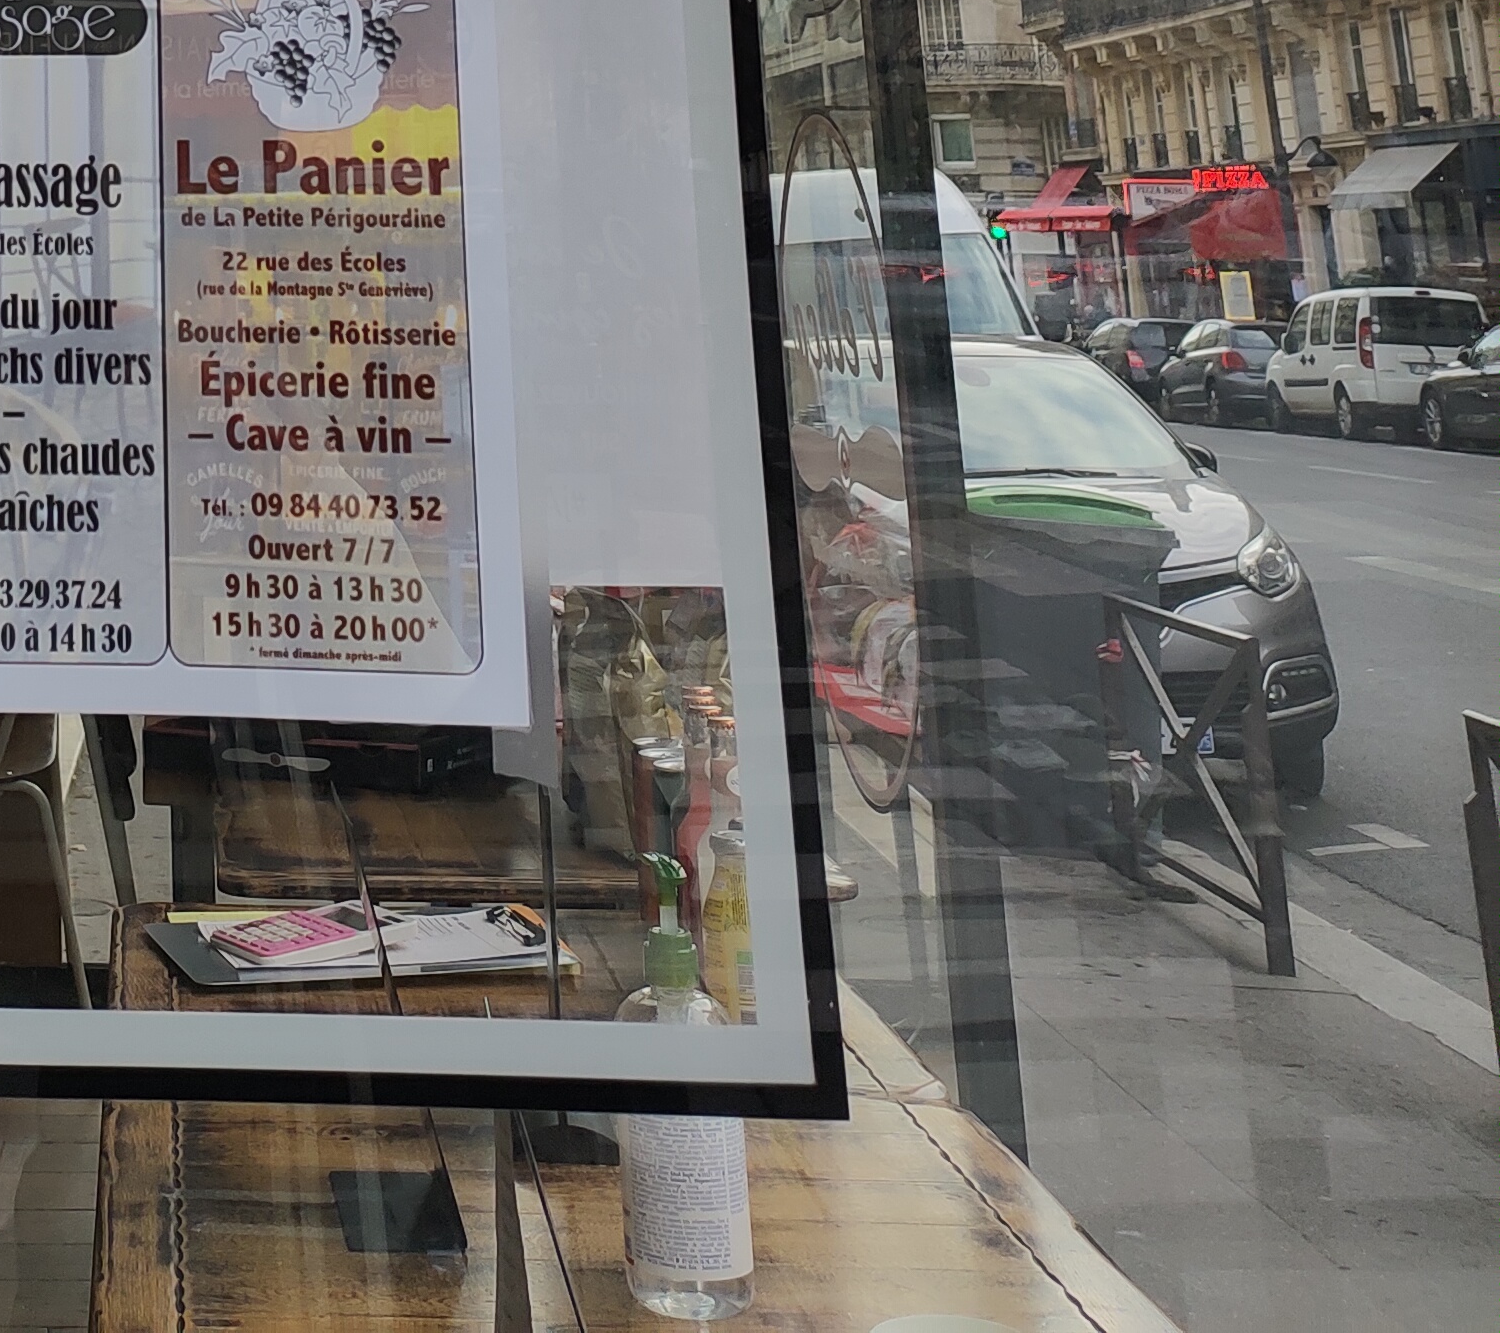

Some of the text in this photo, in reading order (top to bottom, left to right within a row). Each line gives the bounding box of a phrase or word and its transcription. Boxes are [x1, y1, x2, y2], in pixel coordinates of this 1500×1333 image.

[176, 139, 450, 196] Le Panier
[1201, 168, 1270, 190] PIZZA
[181, 206, 446, 233] de La Petite Périgourdine
[33, 228, 94, 256] Écoles
[222, 246, 407, 272] 22 rue des Écoles
[197, 281, 218, 300] (rue
[229, 281, 246, 296] de
[250, 281, 263, 296] la
[267, 282, 333, 300] Montagne
[359, 282, 434, 301] Geneviève)
[0, 293, 40, 330] du
[50, 293, 117, 335] jour
[178, 319, 456, 347] Boucherie Rôtisserie
[54, 347, 151, 385] divers
[200, 350, 436, 407] Épicerie fine
[225, 413, 412, 454] Cave à vin
[23, 437, 155, 476] chaudes
[249, 534, 333, 561] Ouvert
[309, 575, 322, 601] à
[25, 620, 39, 651] à
[310, 614, 323, 640] à
[292, 648, 341, 660] dimanche
[345, 650, 402, 663] après-midi
